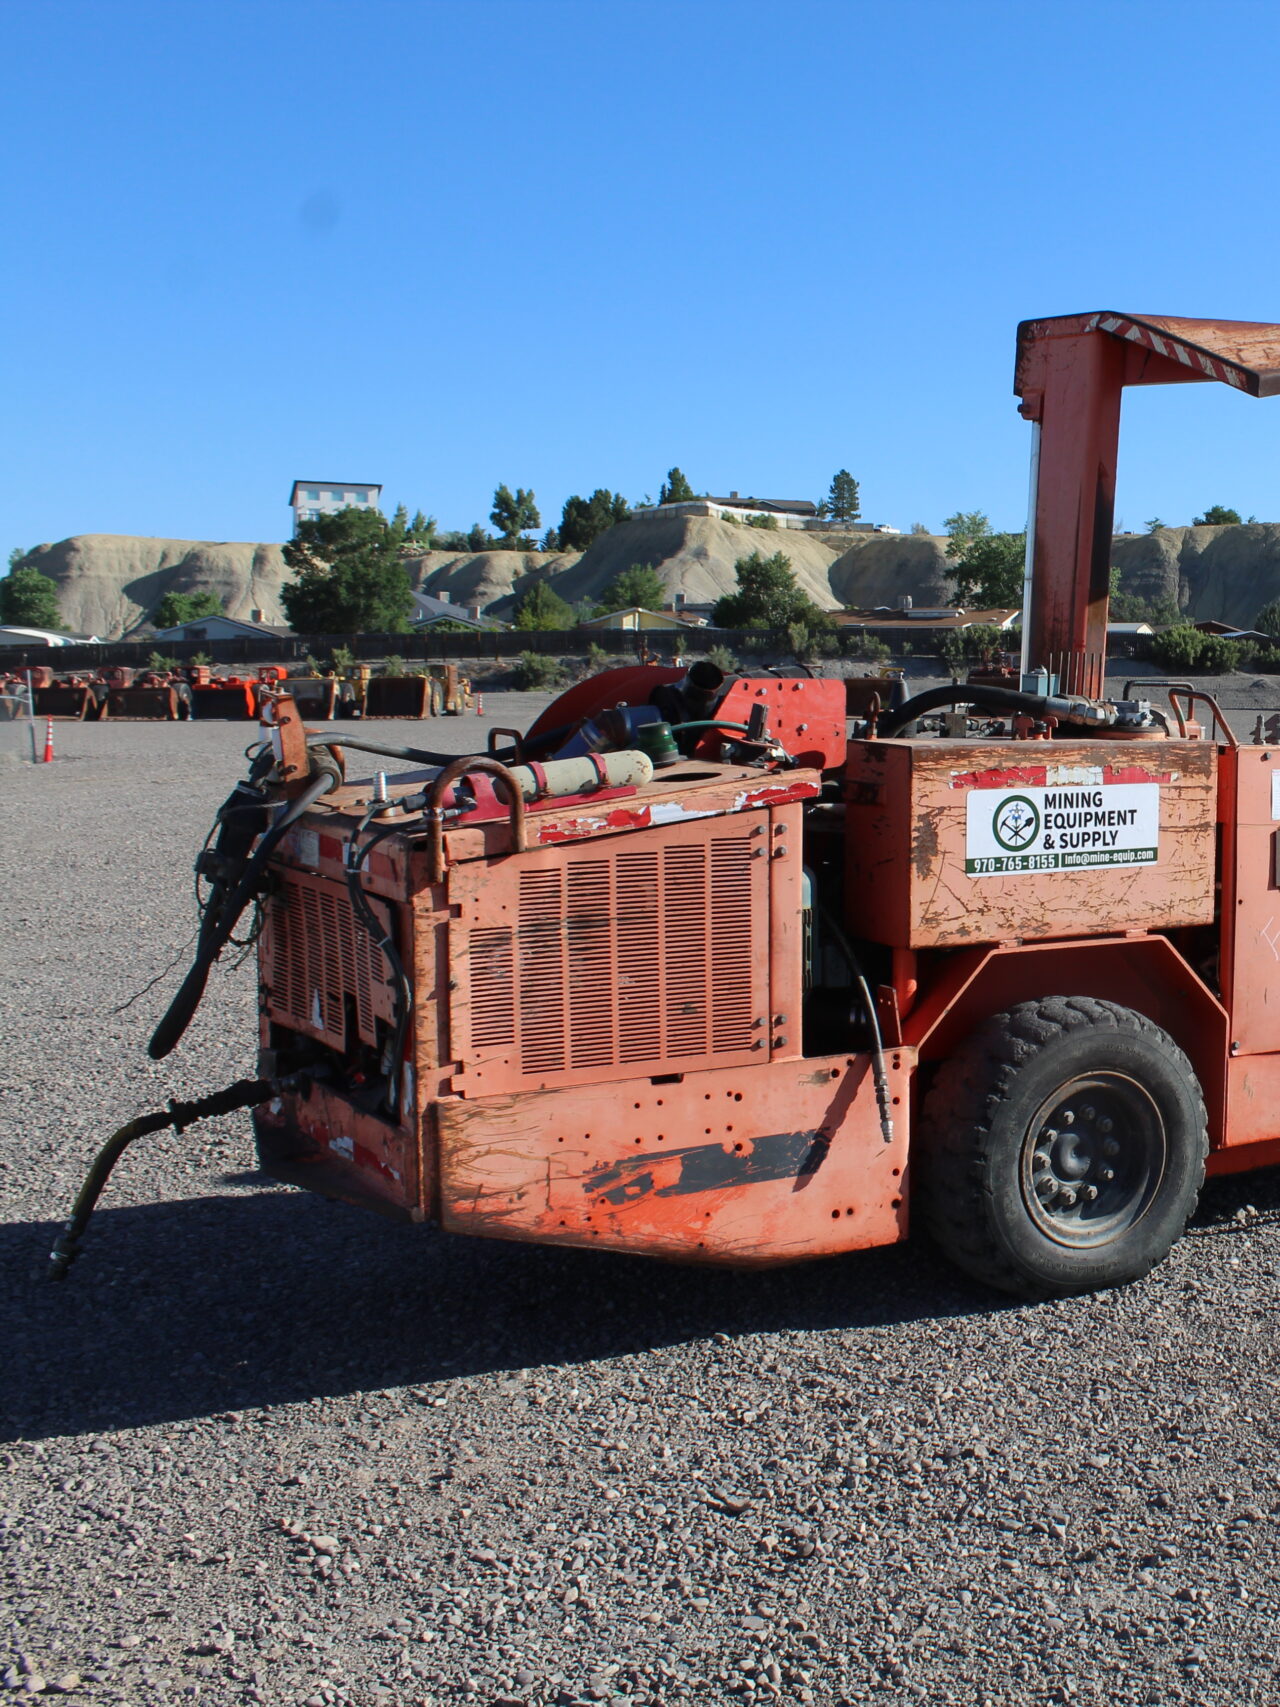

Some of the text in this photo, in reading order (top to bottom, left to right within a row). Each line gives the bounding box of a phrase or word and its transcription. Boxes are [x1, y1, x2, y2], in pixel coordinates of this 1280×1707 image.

[1044, 791, 1103, 810] MINING
[1044, 809, 1137, 830] EQUIPMENT
[1043, 830, 1119, 850] & SUPPLY
[974, 855, 1055, 872] 970-765-8155
[1064, 849, 1154, 866] Info@mine-equip.com
